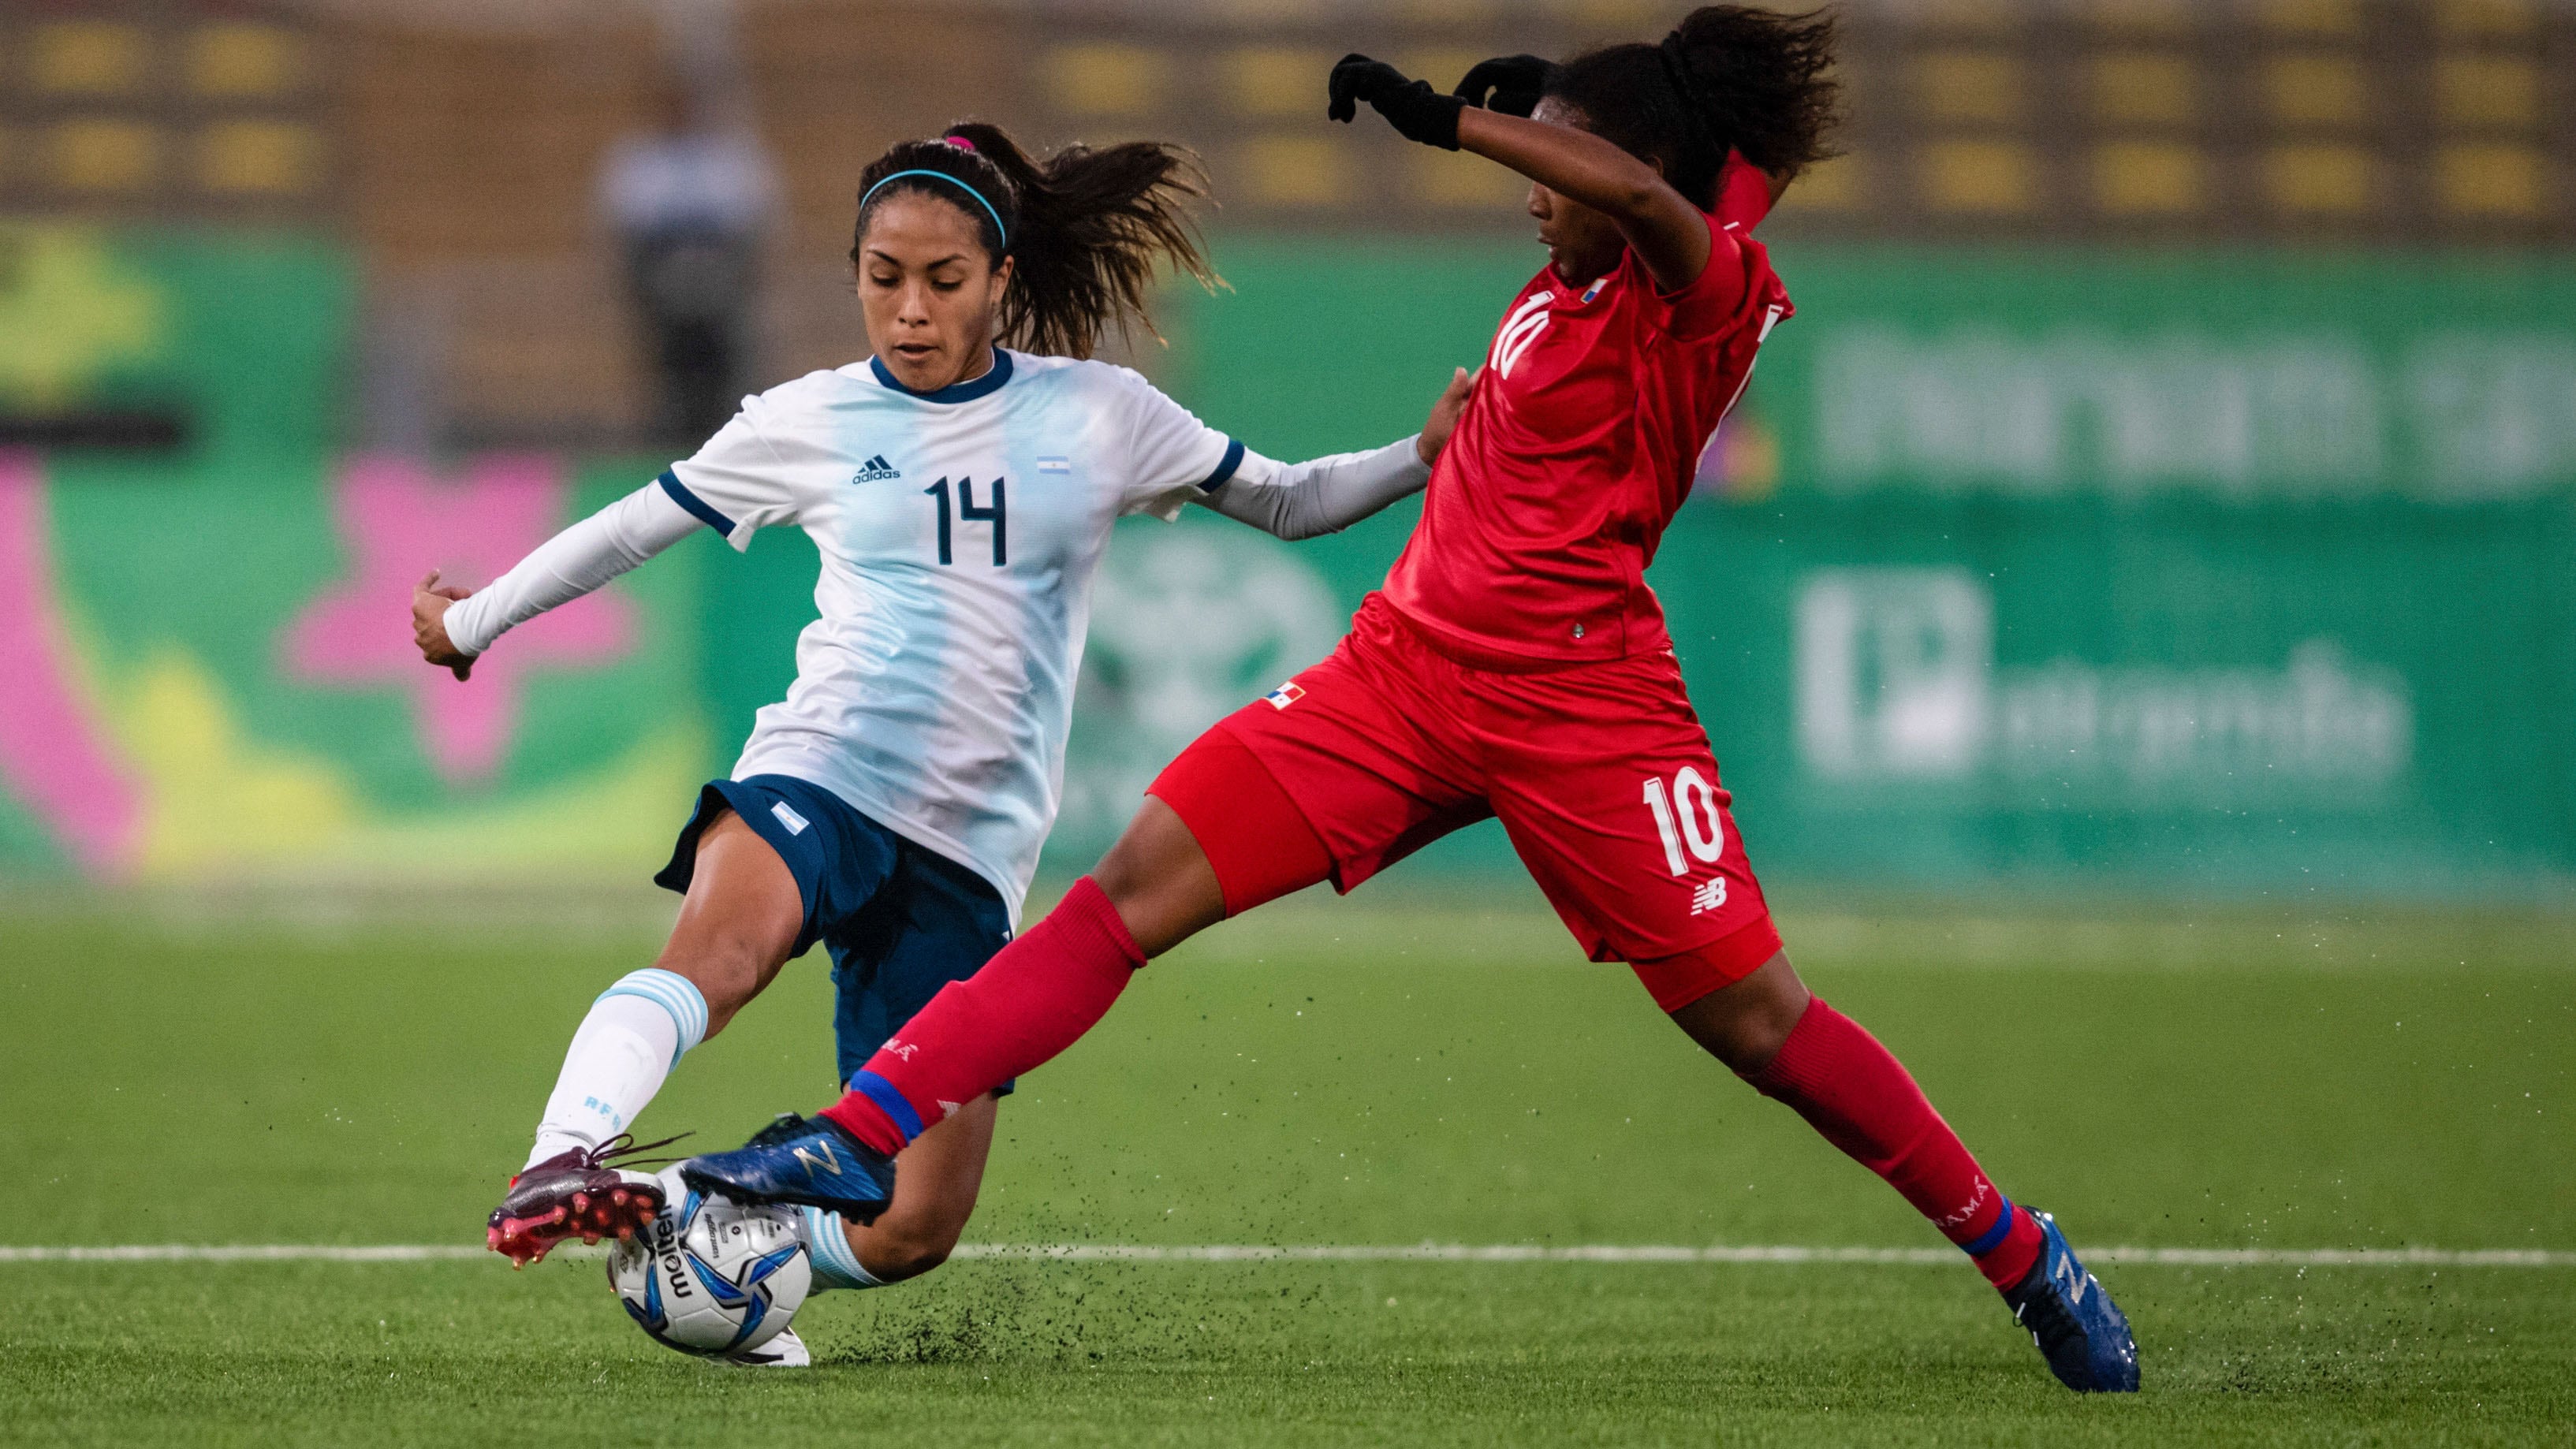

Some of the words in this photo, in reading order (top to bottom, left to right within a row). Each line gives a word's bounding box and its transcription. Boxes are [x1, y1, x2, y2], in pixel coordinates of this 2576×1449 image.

[1490, 290, 1555, 380] 10
[852, 469, 900, 485] adidas
[923, 475, 1006, 566] 14
[1643, 765, 1724, 877] 10
[657, 1204, 692, 1298] molten
